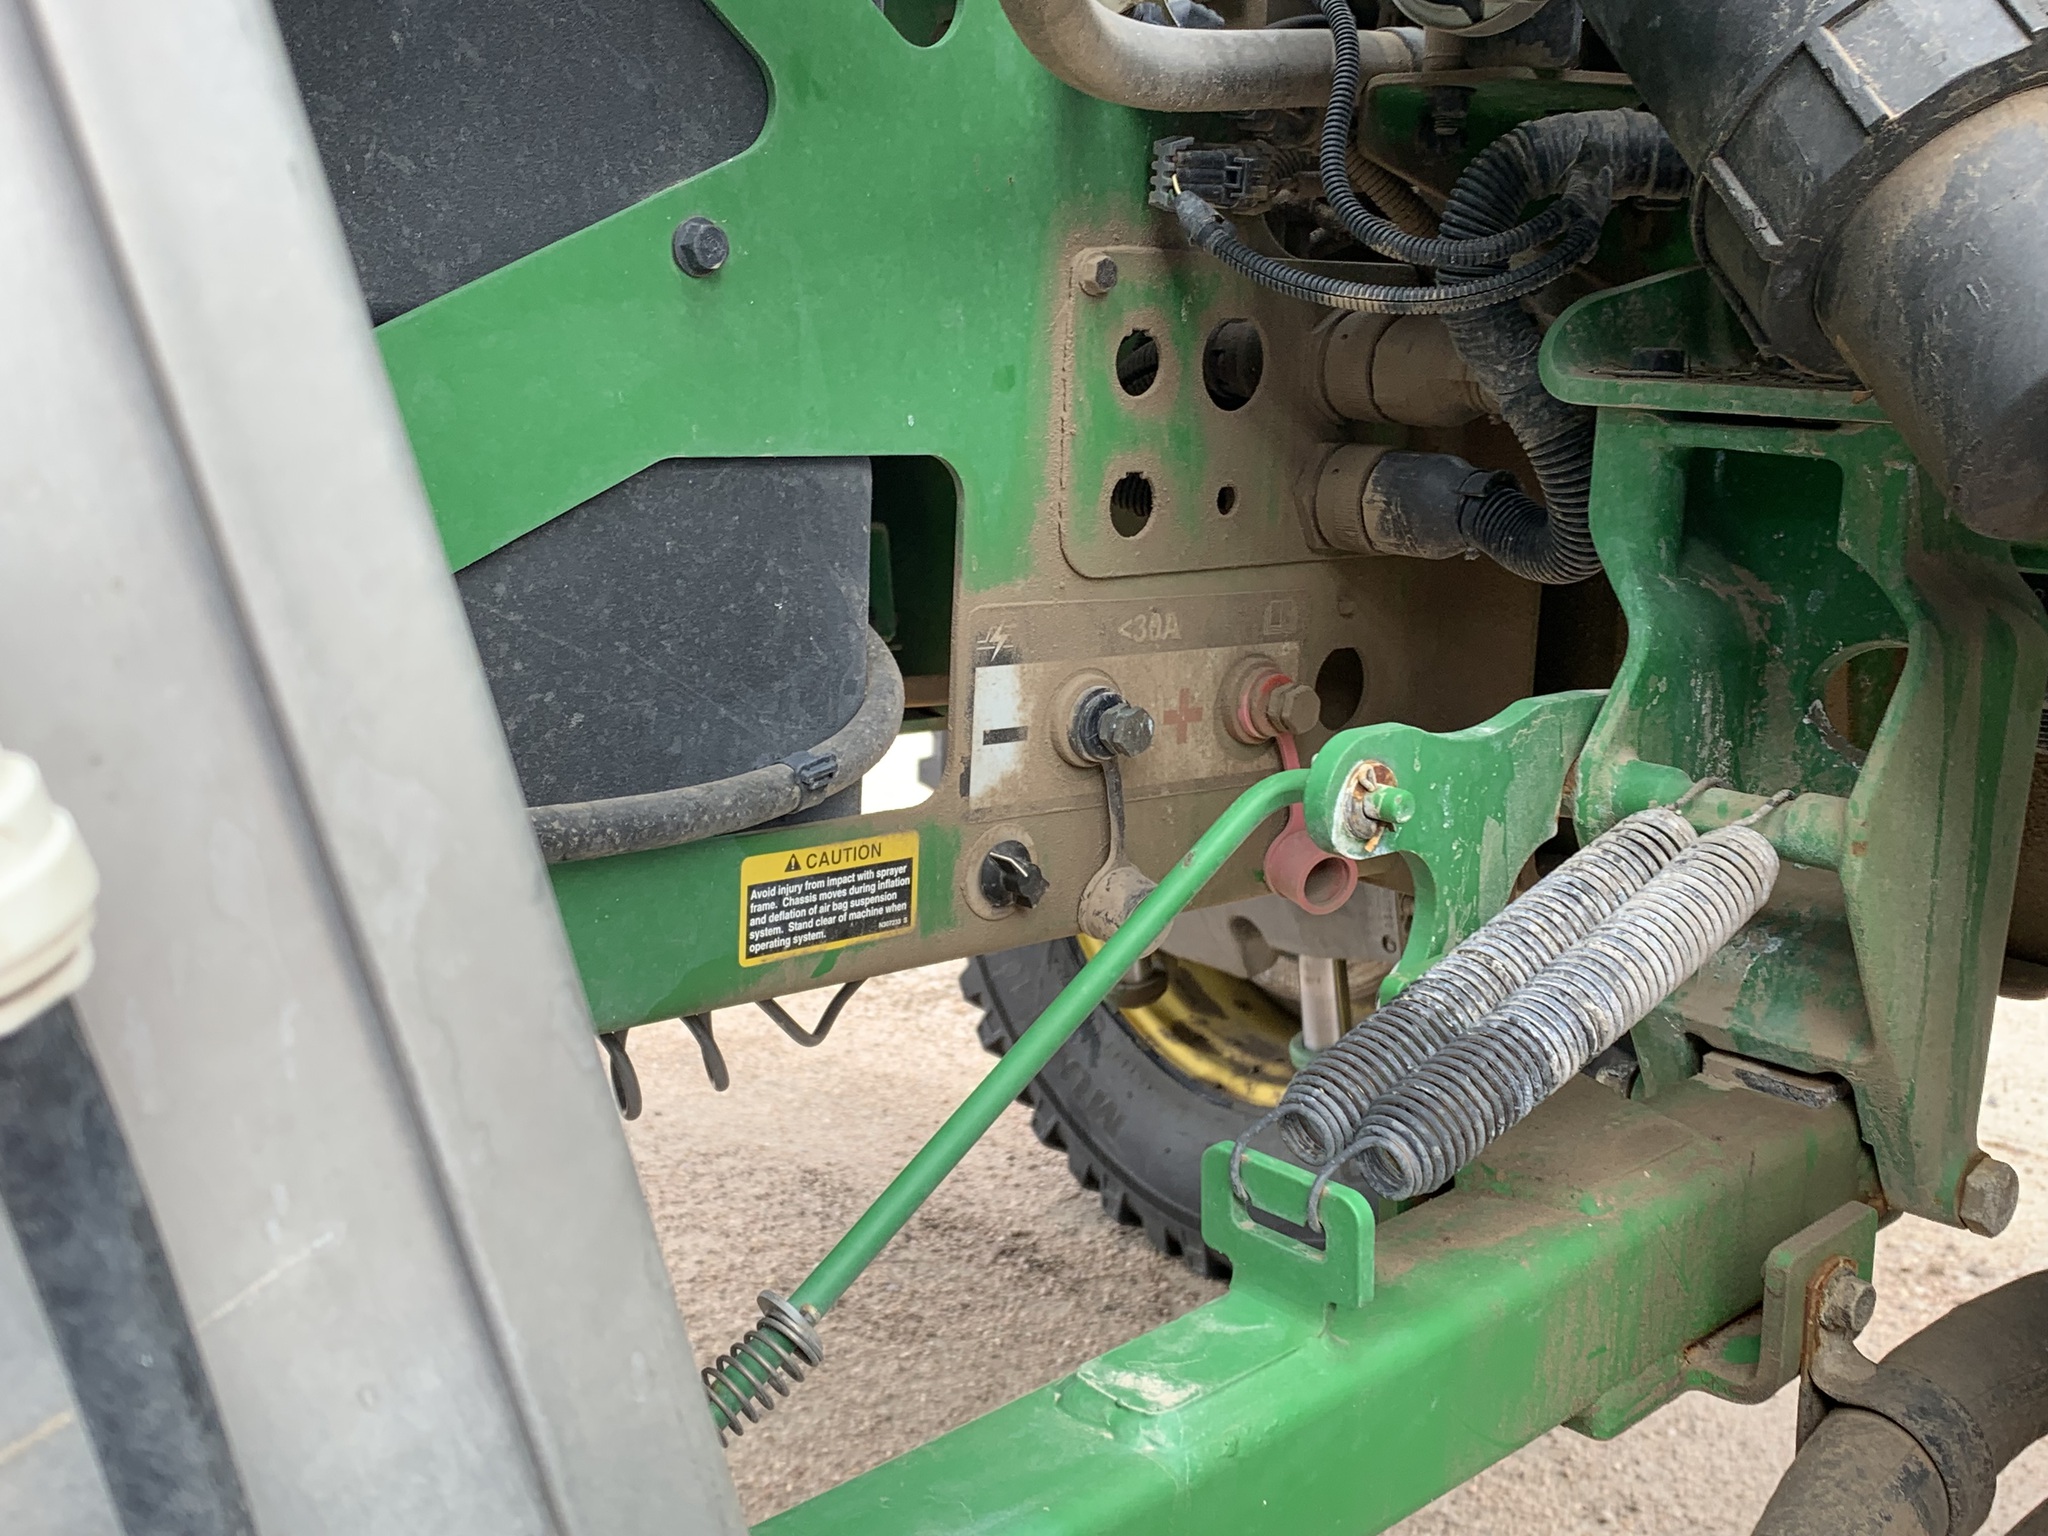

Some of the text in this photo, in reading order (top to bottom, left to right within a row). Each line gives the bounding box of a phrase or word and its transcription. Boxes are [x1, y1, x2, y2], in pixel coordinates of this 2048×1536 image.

[806, 843, 882, 868] CAUTION
[751, 865, 907, 900] Avoid injury from impact with sprayer
[751, 876, 910, 913] frame. Chassis moves during inflation
[749, 902, 907, 941] system. Stand clear of machine when
[750, 891, 897, 926] and deflation of air bag suspension
[749, 930, 826, 953] operating system.
